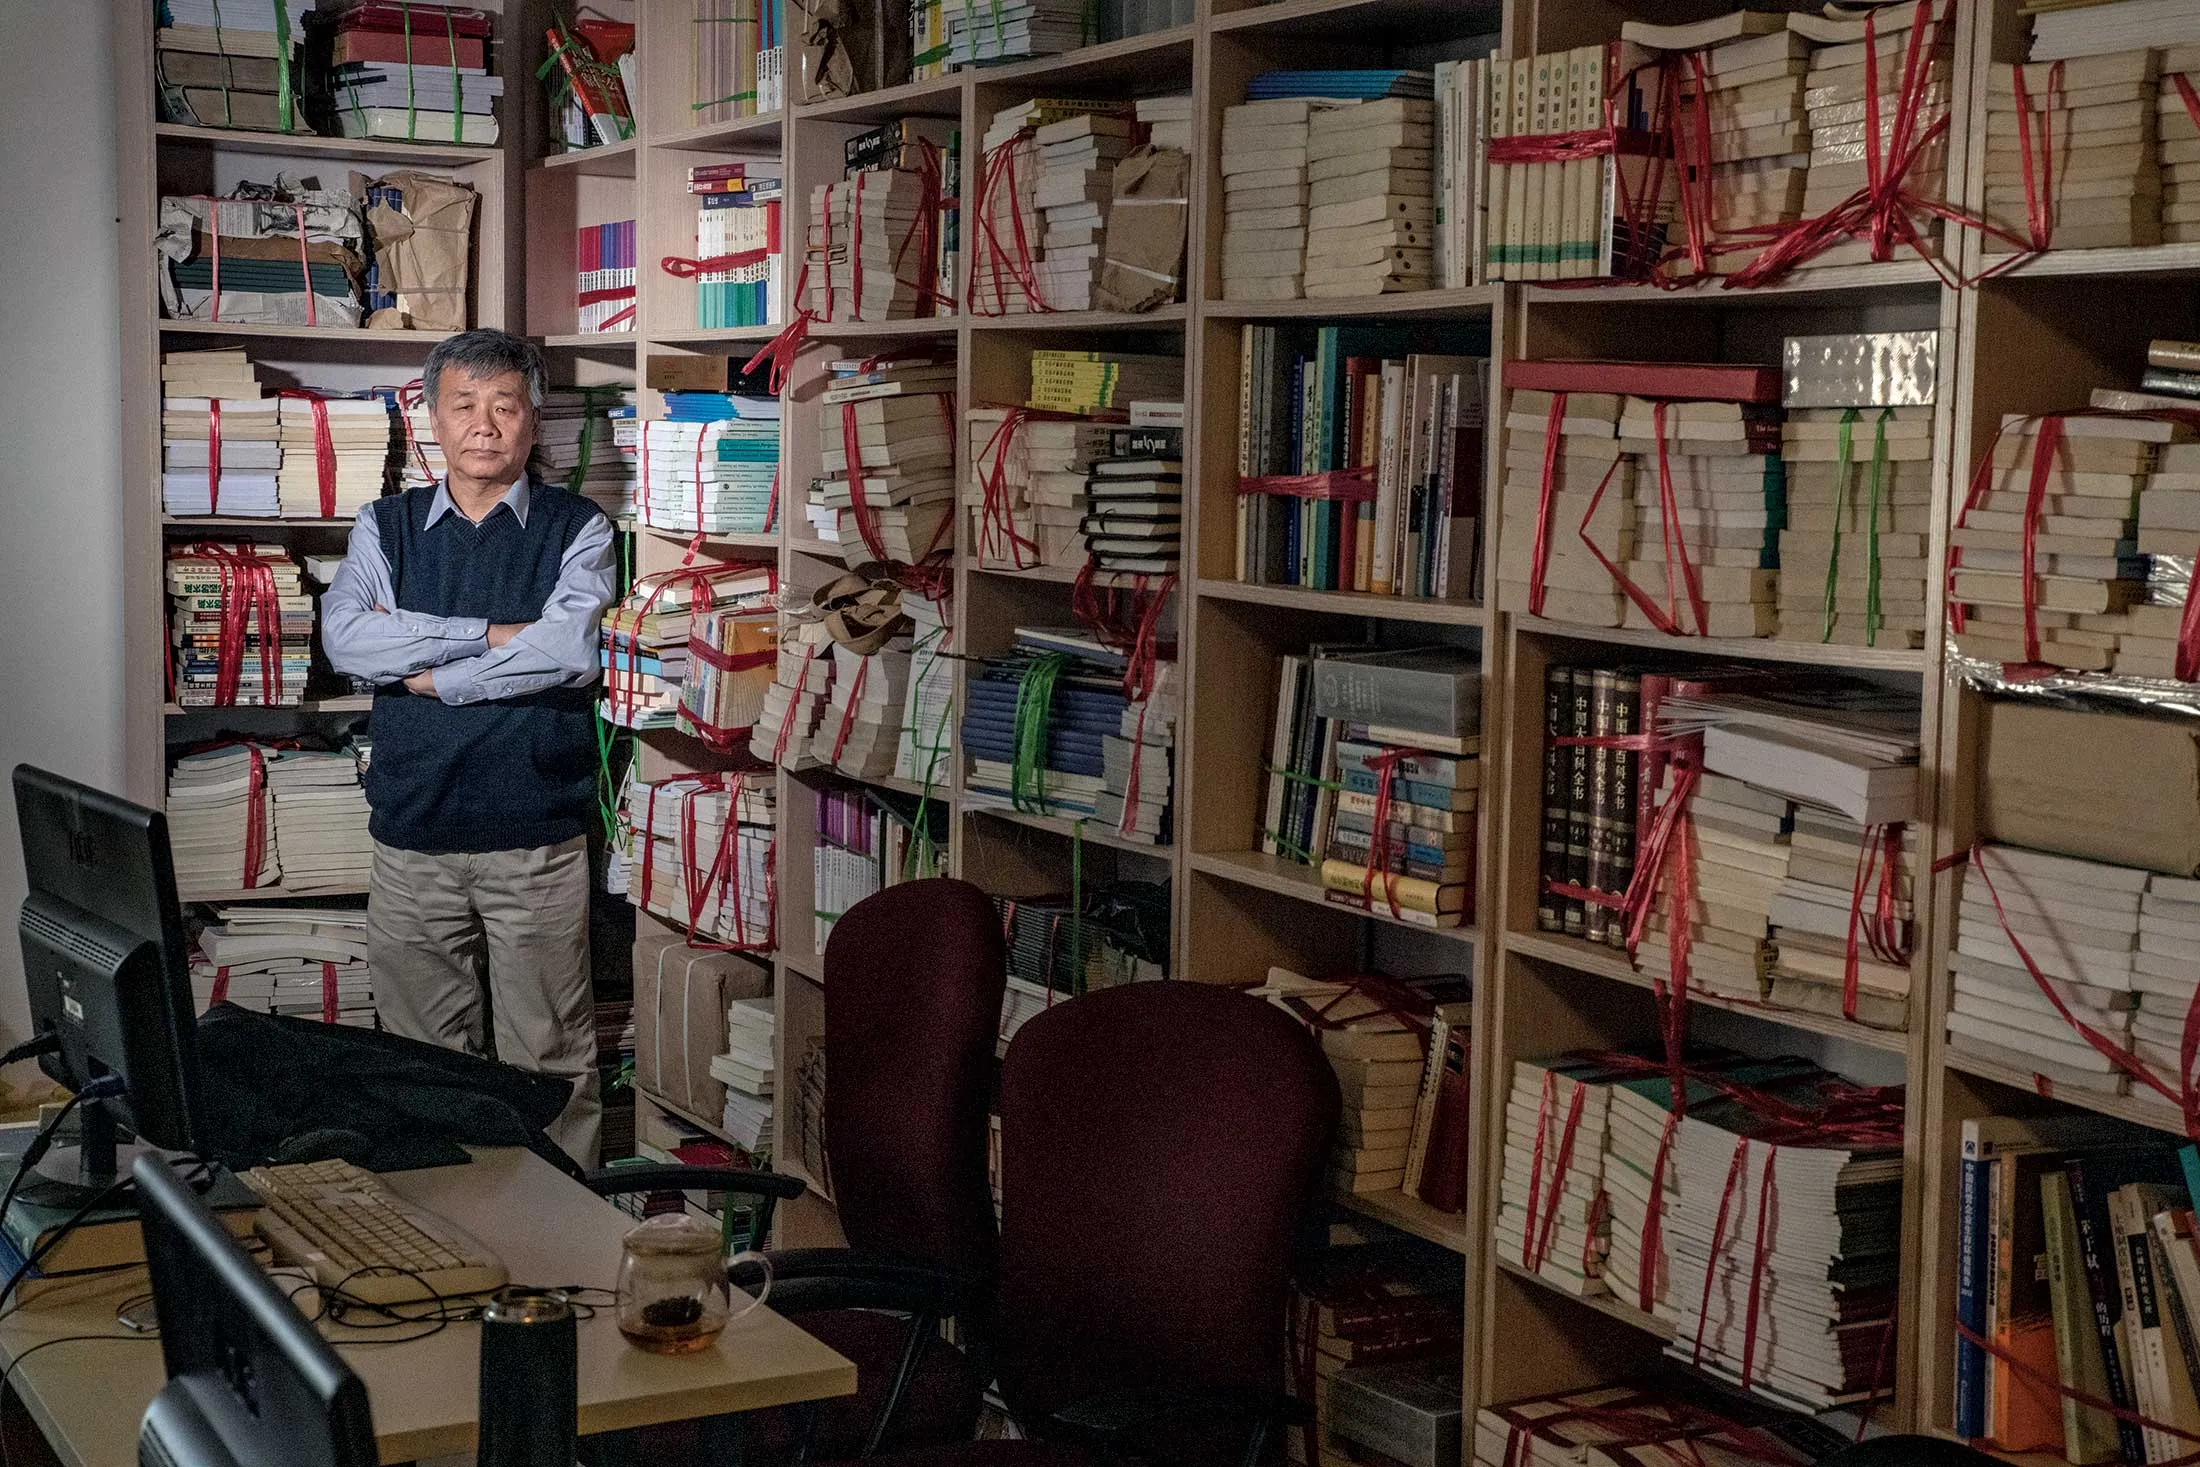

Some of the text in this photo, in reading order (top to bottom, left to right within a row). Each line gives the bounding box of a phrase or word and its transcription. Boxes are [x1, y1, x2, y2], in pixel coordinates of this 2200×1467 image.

[1548, 694, 1559, 794] 中国大科全书
[1594, 699, 1610, 804] 中国百科全书
[1614, 702, 1629, 811] 中国百科全书
